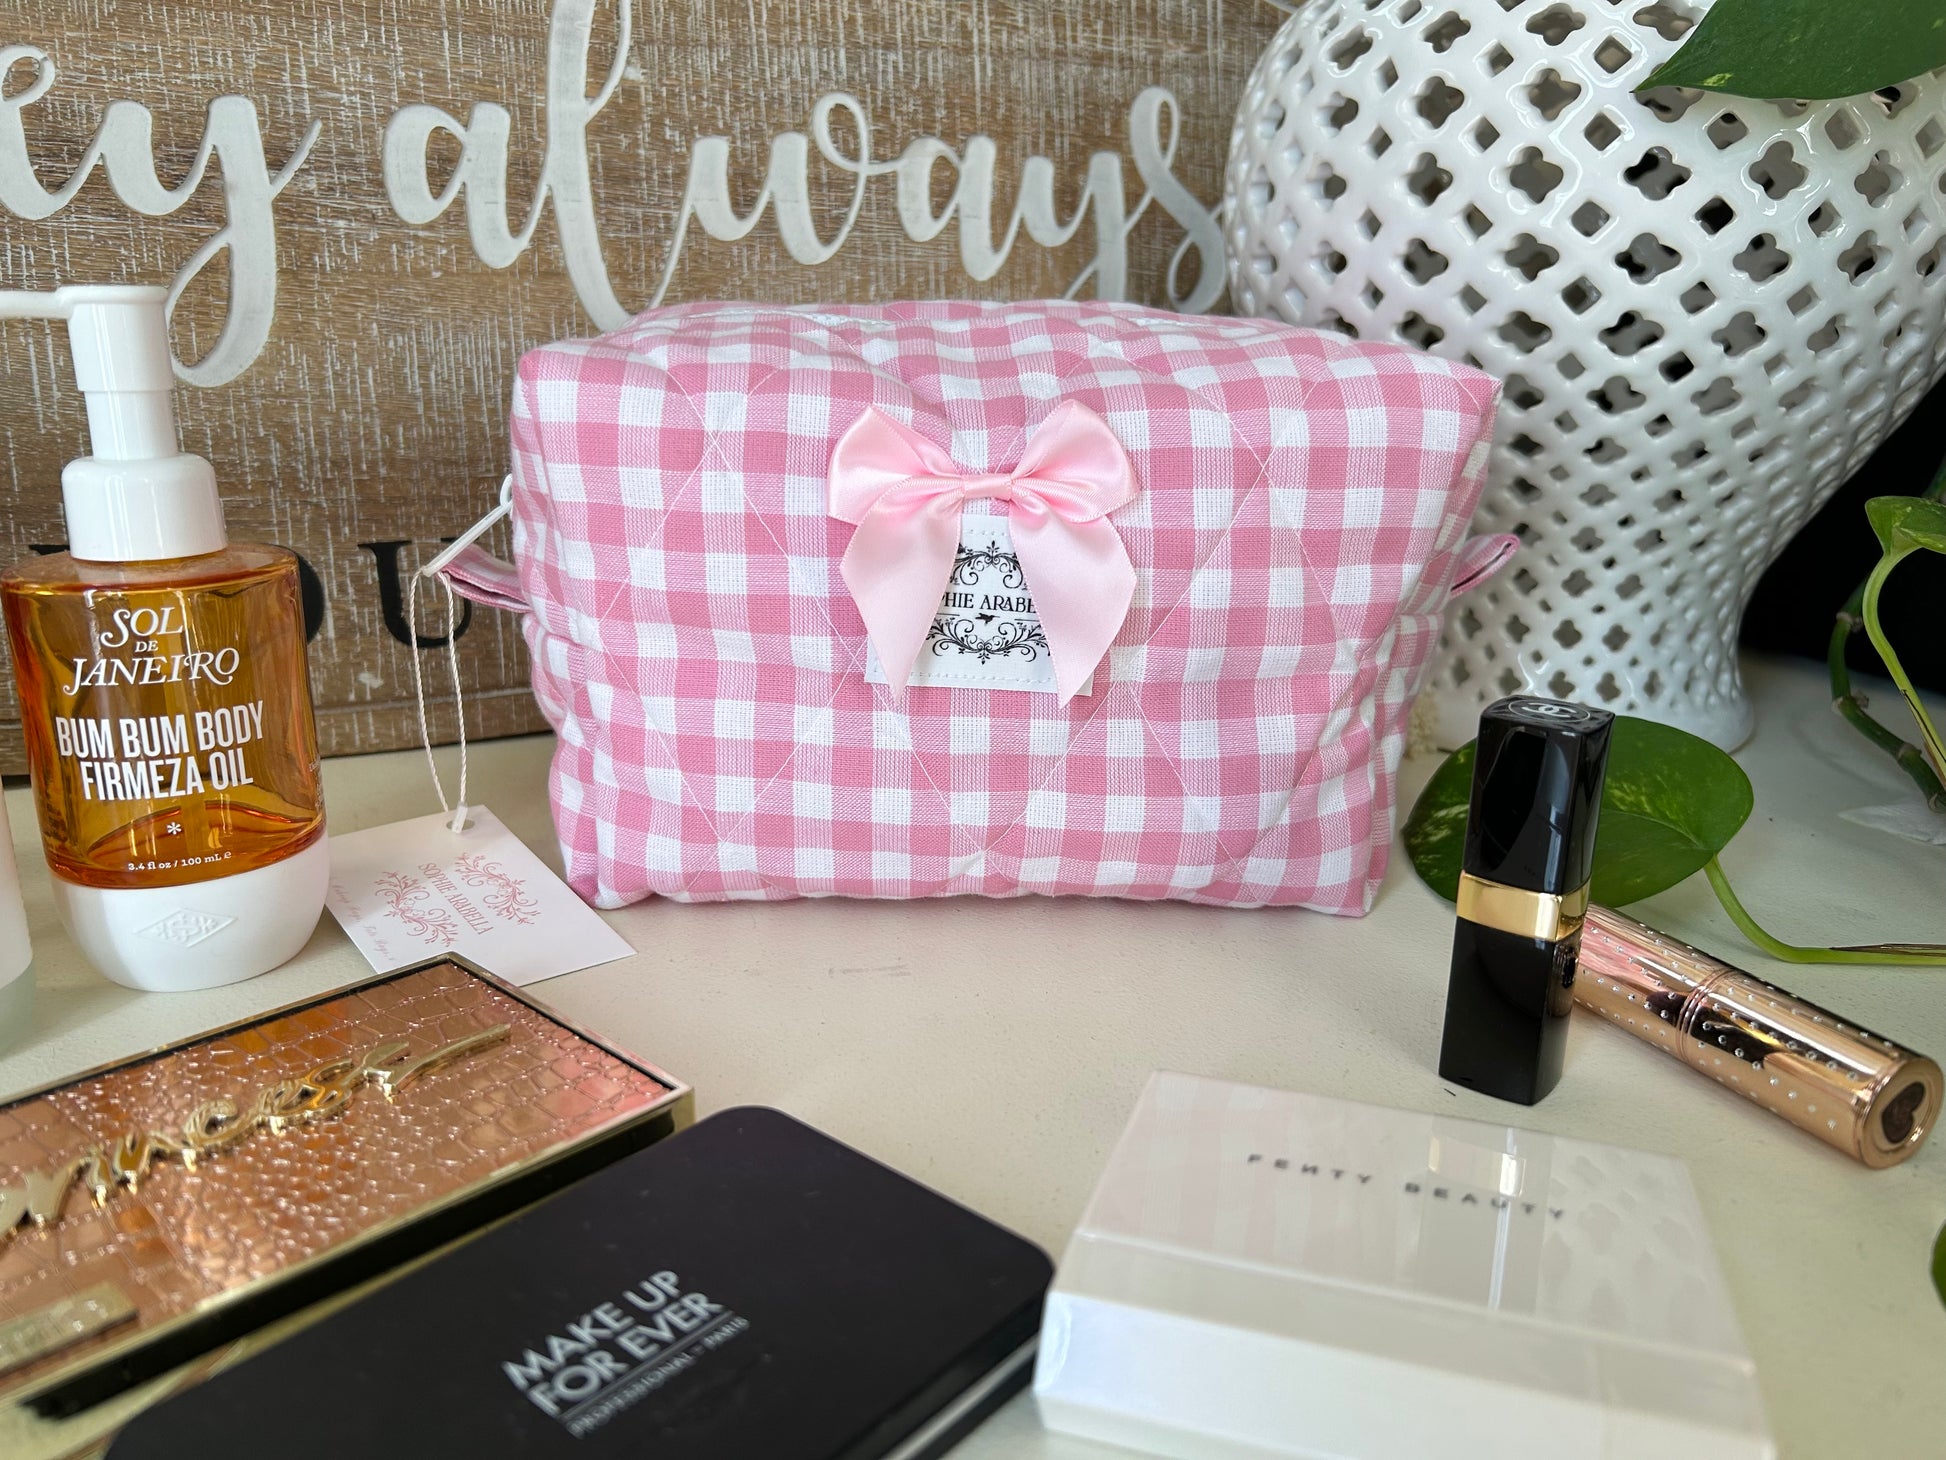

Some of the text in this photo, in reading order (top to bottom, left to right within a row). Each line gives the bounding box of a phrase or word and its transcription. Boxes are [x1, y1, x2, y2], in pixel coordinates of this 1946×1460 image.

[383, 0, 1228, 332] always
[100, 606, 183, 648] SOL
[942, 591, 974, 609] HIE
[62, 647, 240, 696] JANEIRO
[135, 640, 159, 653] DE
[55, 700, 264, 759] BUM BUM BODY
[79, 747, 254, 801] FIRMEZA OIL
[128, 863, 146, 871] 3.4
[147, 861, 157, 870] fl
[158, 861, 172, 869] oz
[181, 857, 202, 867] 100
[204, 853, 222, 863] mL
[418, 862, 494, 935] SOPHIE ARABELLA
[1247, 1154, 1564, 1220] FENTY BEAUTY
[501, 1270, 681, 1391] MAKE UP
[526, 1292, 727, 1419] FOR EVER
